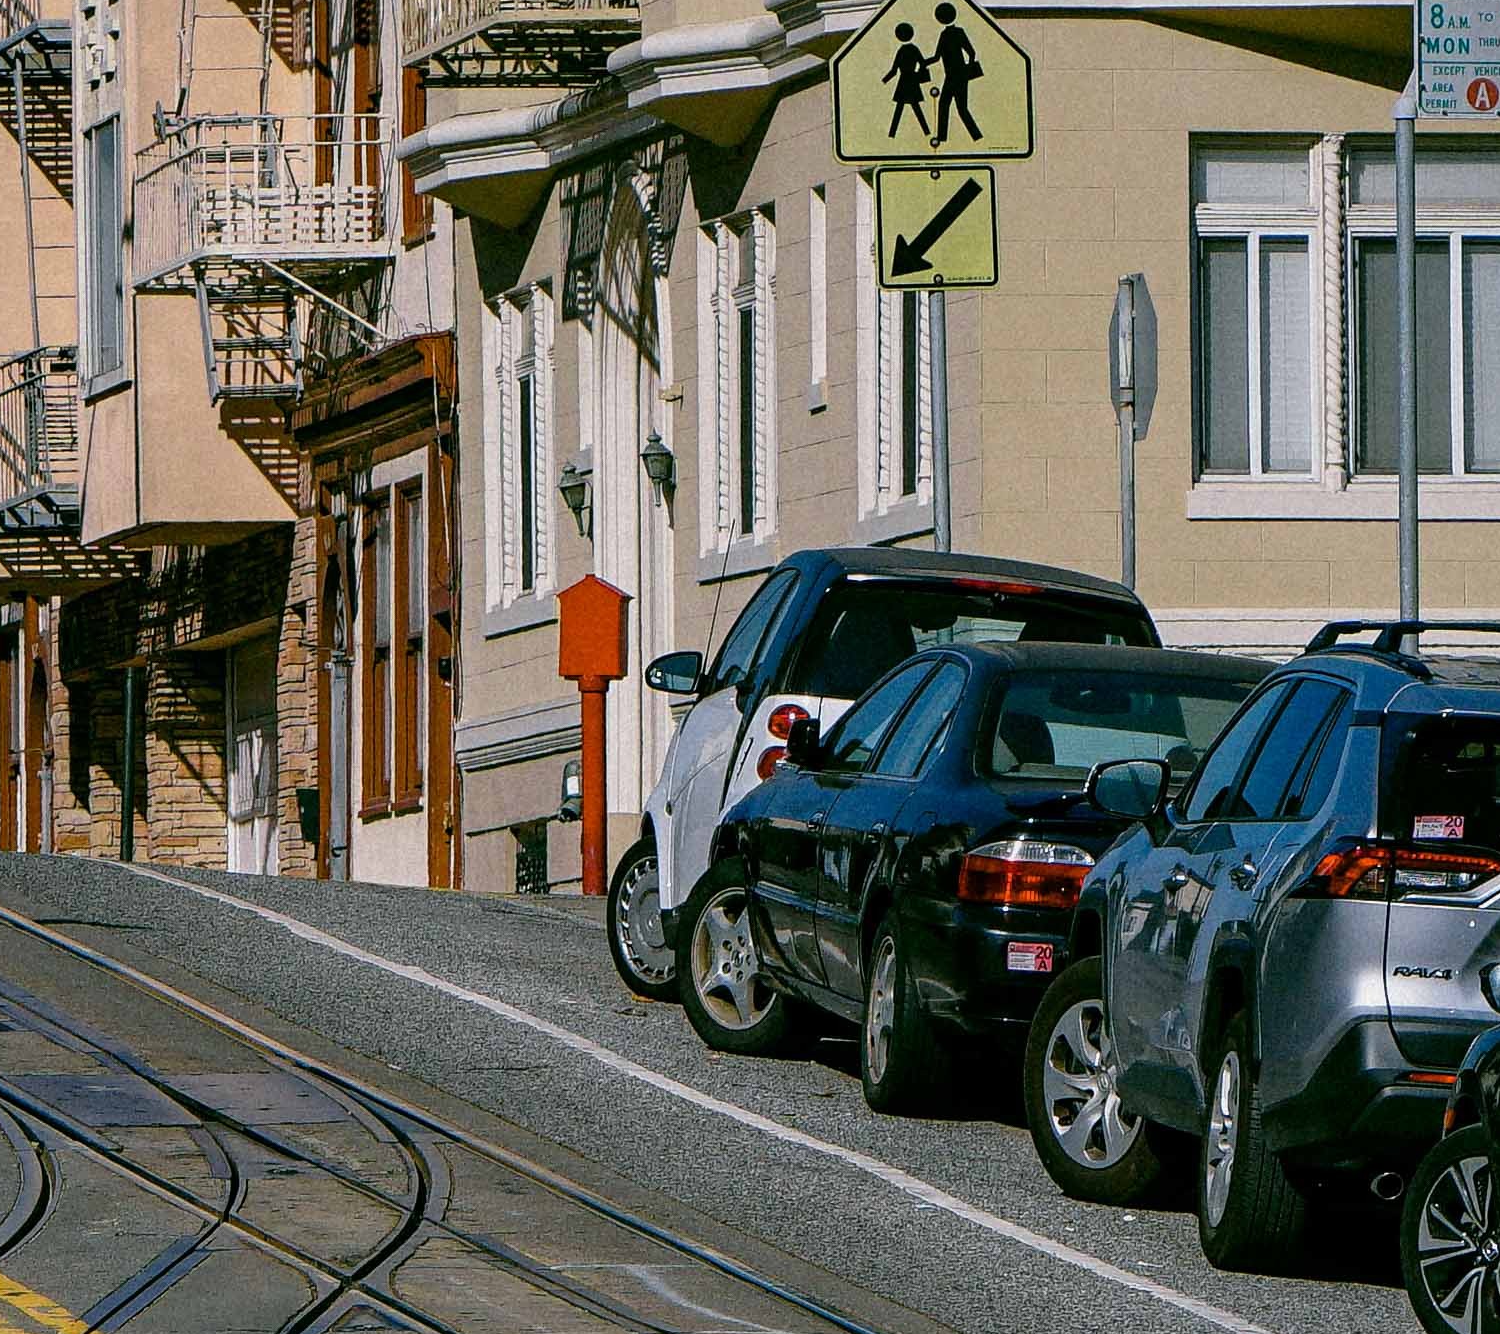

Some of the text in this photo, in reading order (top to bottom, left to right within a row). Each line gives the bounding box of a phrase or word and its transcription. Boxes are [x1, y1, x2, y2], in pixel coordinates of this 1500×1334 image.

[1430, 3, 1444, 29] 8
[1447, 16, 1471, 29] A.M.
[1478, 12, 1494, 22] TO
[1426, 37, 1470, 54] MON
[1479, 37, 1500, 48] THRU
[1432, 66, 1466, 76] EXCEPT
[1431, 82, 1455, 93] AREA
[1474, 82, 1491, 108] A
[1426, 98, 1457, 109] PERMIT
[1445, 816, 1463, 828] 20
[1447, 828, 1459, 837] A
[1036, 945, 1052, 960] 20
[1037, 960, 1048, 971] A
